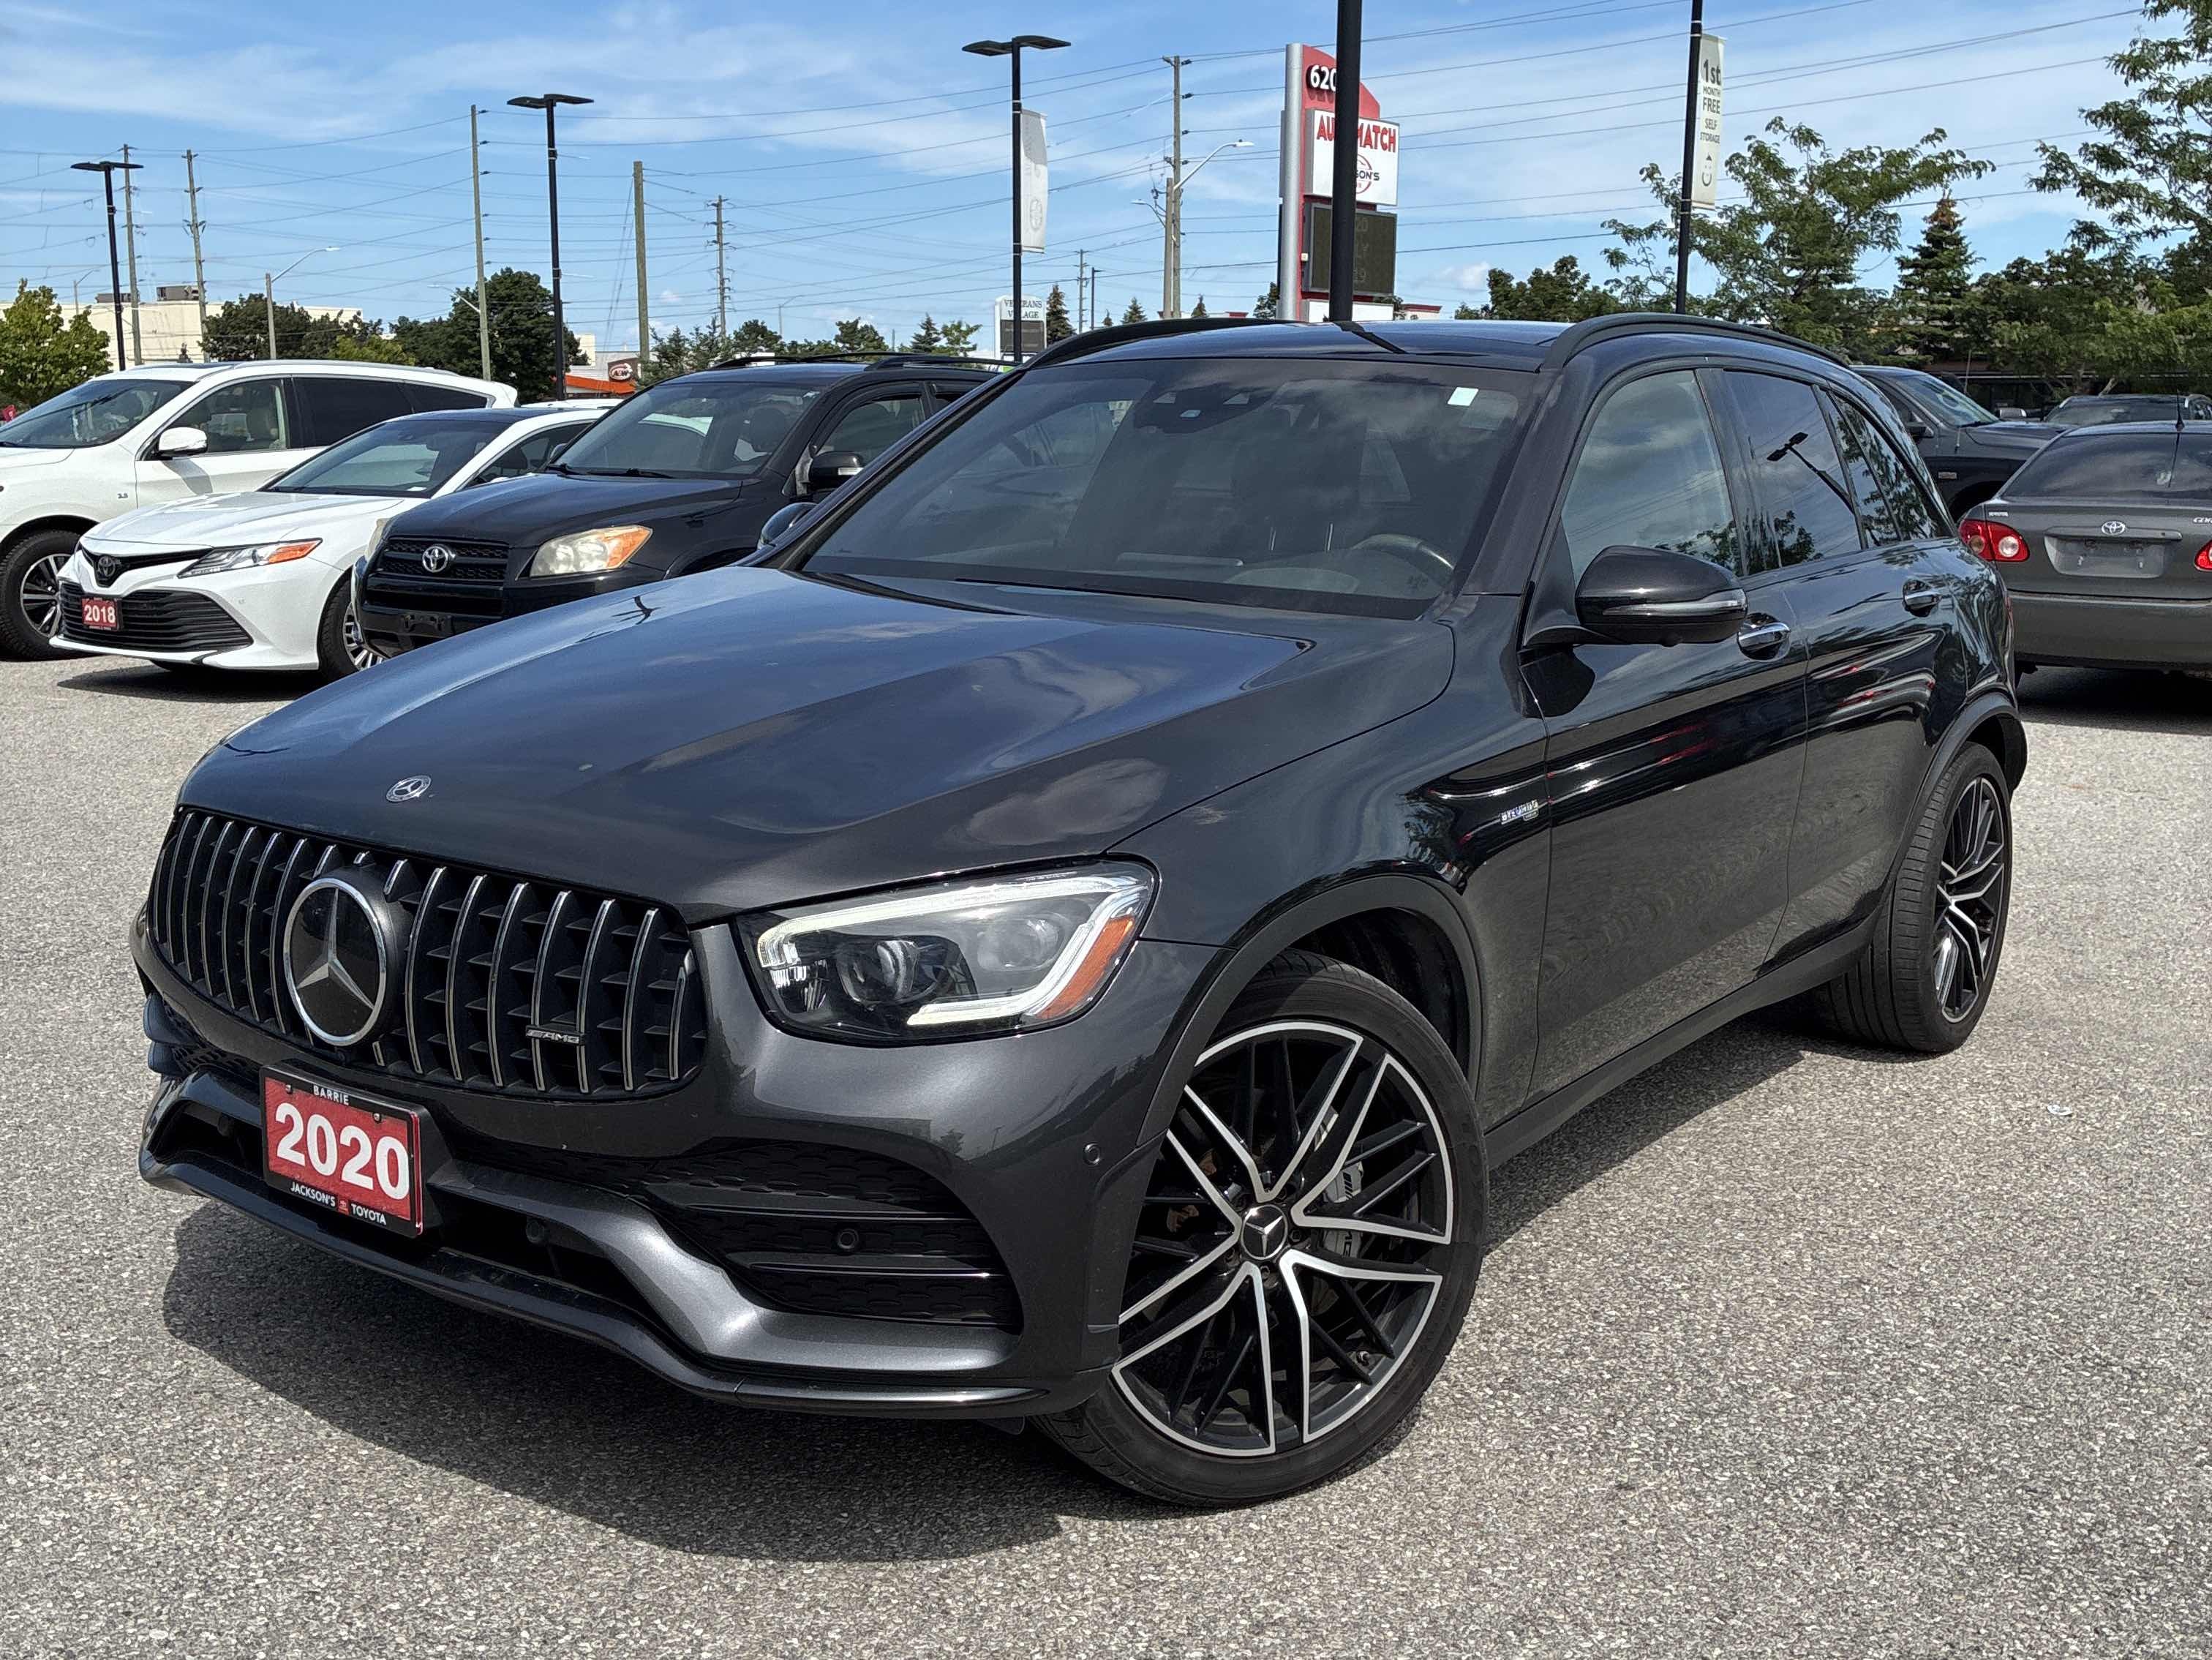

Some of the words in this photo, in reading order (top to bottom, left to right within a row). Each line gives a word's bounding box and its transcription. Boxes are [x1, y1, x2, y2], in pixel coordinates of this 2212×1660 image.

[1704, 59, 1721, 86] 1st
[1703, 86, 1720, 97] MONTH
[1703, 97, 1720, 114] FREE
[1704, 118, 1718, 130] SELF
[1700, 132, 1720, 143] STORAGE
[84, 604, 116, 623] 2018
[313, 1085, 350, 1106] BARRIE
[275, 1102, 410, 1201] 2020
[290, 1182, 336, 1208] JACKSON'S
[351, 1203, 387, 1226] TOYOTA
